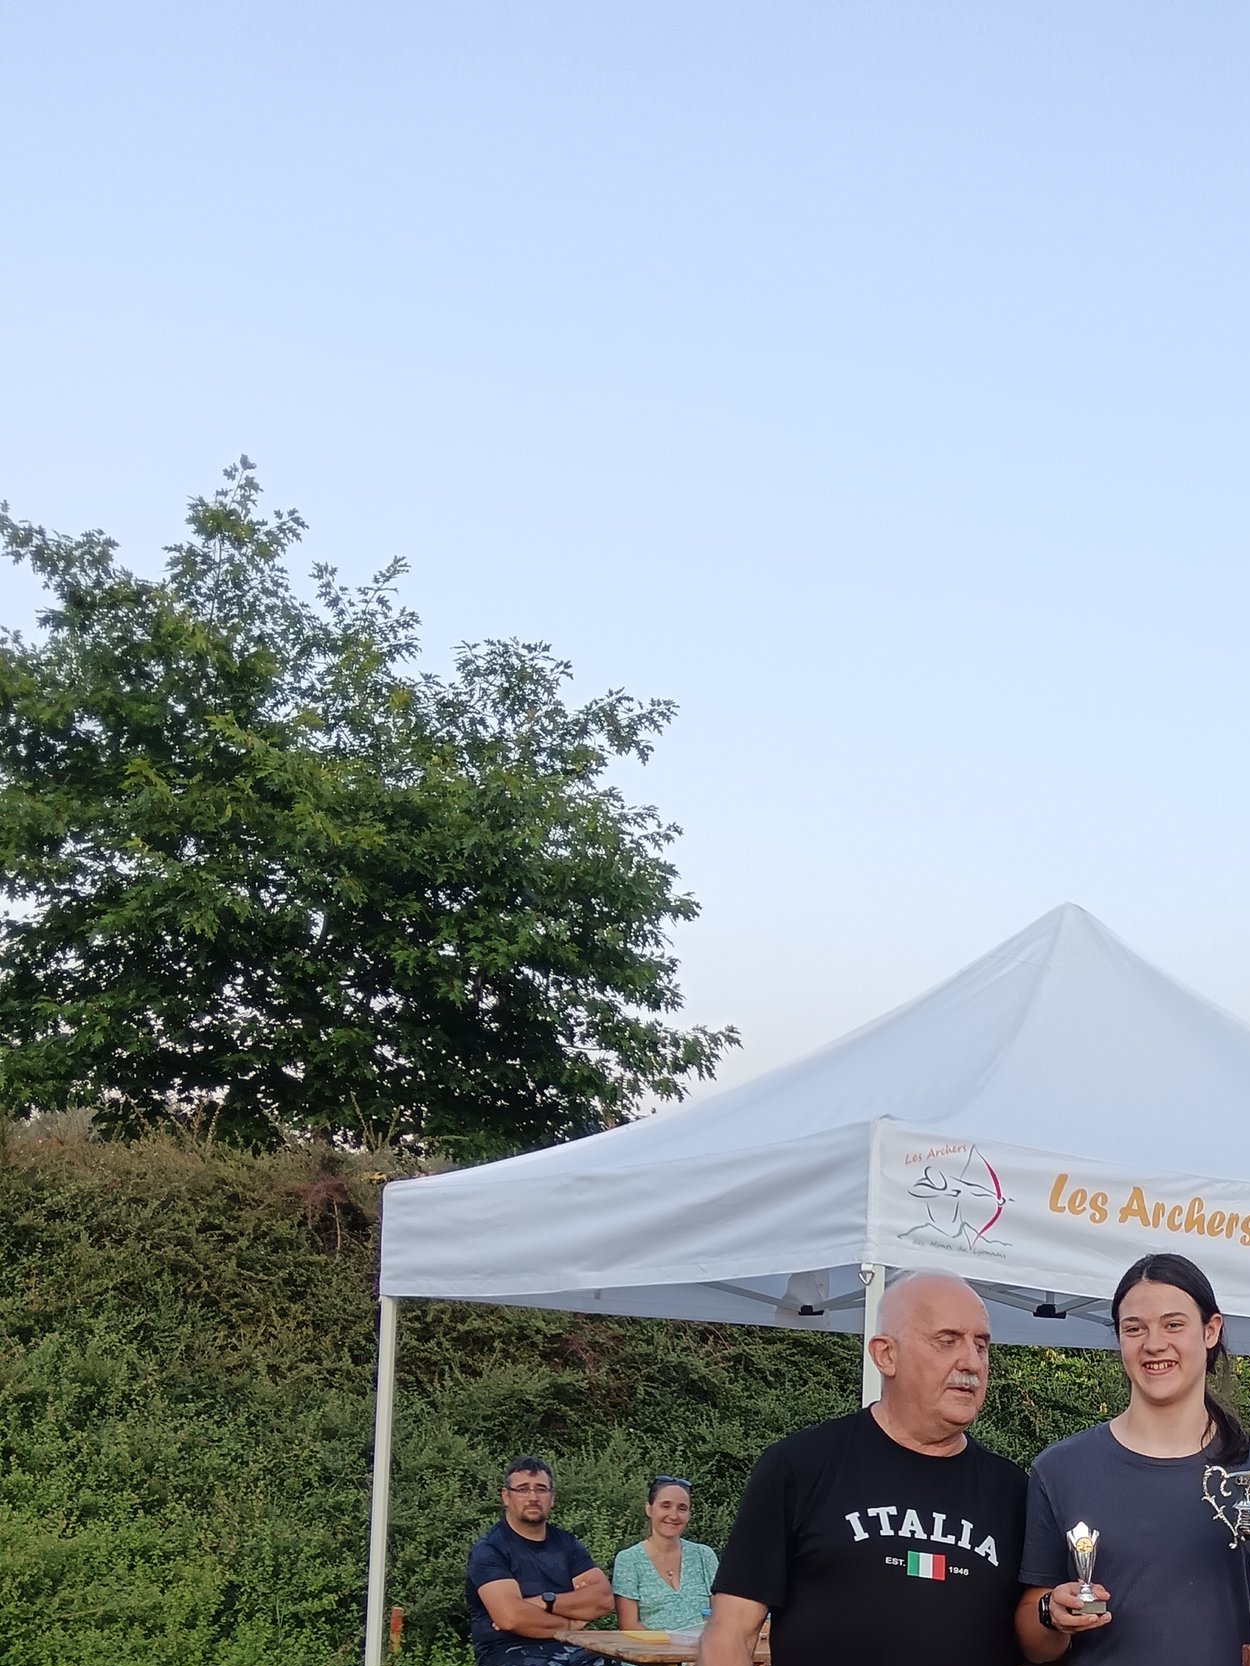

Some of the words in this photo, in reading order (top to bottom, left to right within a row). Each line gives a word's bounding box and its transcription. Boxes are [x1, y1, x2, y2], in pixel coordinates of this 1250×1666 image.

[904, 1153, 923, 1165] Les
[926, 1144, 967, 1159] Archers
[1049, 1173, 1109, 1224] Les
[845, 1505, 999, 1567] ITALIA
[885, 1556, 906, 1567] EST.
